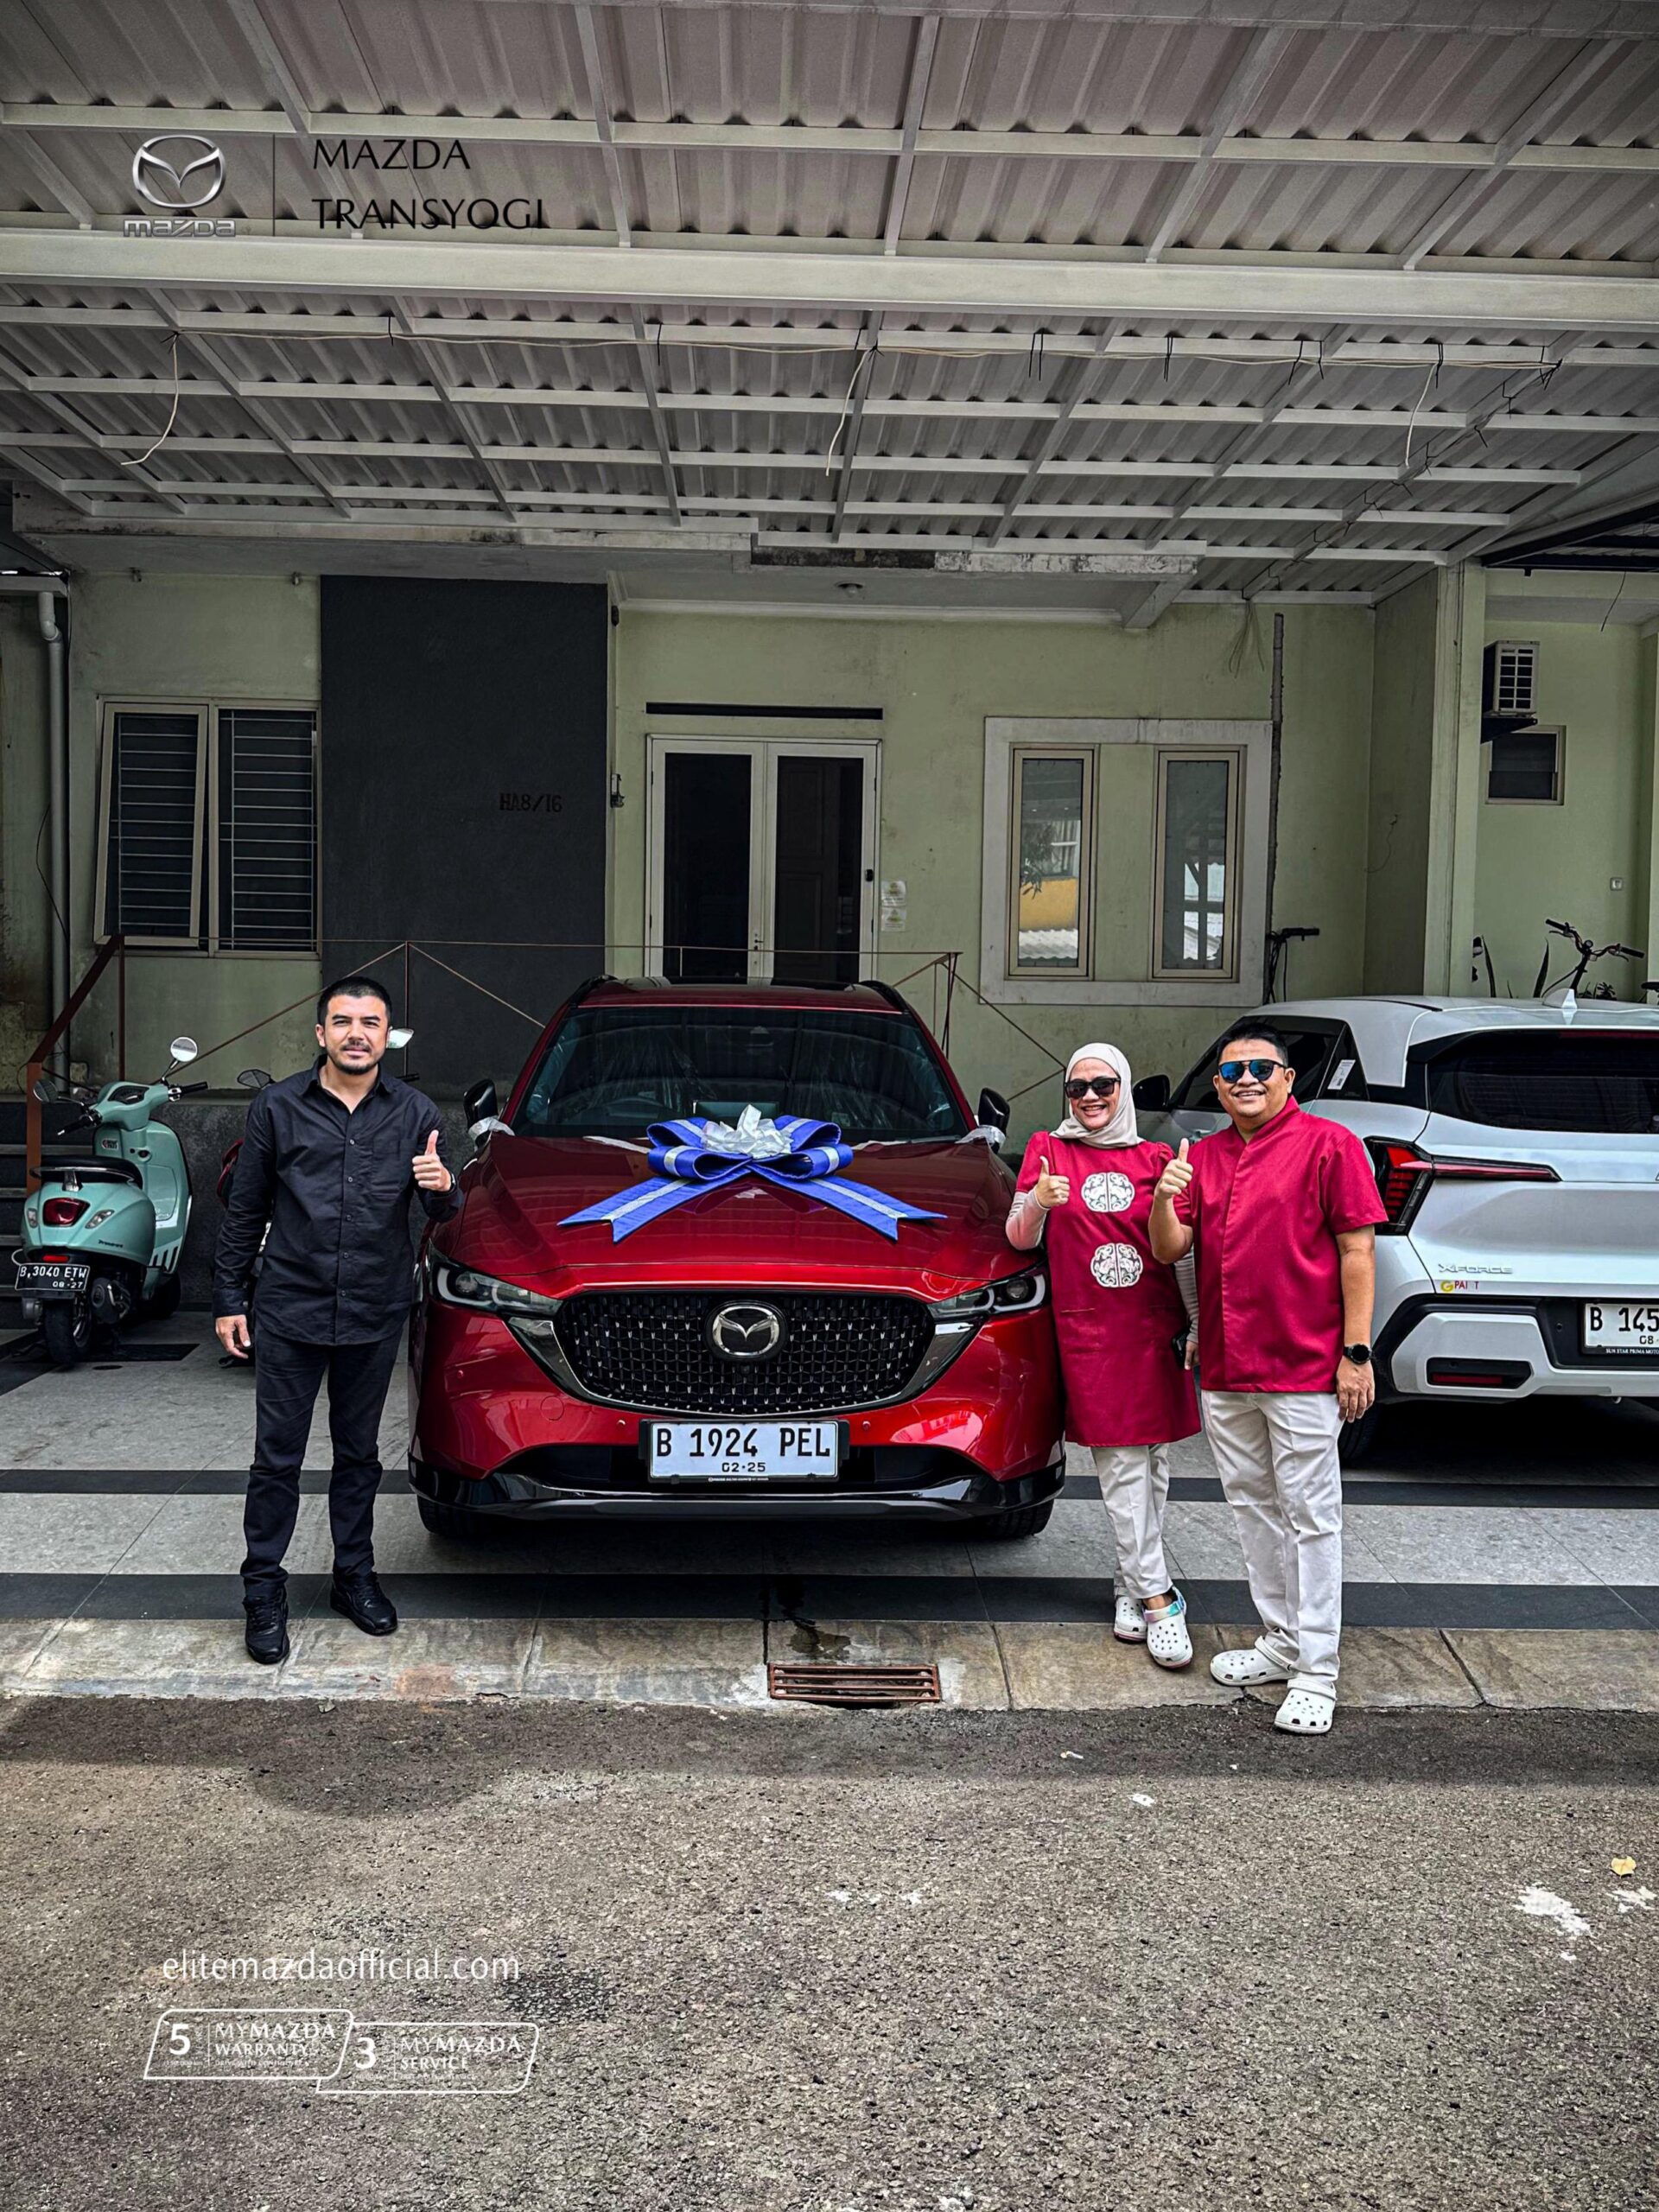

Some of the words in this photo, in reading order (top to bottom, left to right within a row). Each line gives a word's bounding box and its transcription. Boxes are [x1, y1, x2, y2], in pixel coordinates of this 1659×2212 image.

[19, 1266, 27, 1277] B
[32, 1266, 60, 1277] 3040
[64, 1267, 86, 1278] ETW
[1438, 1264, 1513, 1274] XFORCE
[1590, 1306, 1603, 1331] B
[657, 1427, 671, 1457] B
[689, 1427, 759, 1457] 1924
[779, 1427, 830, 1457] PEL
